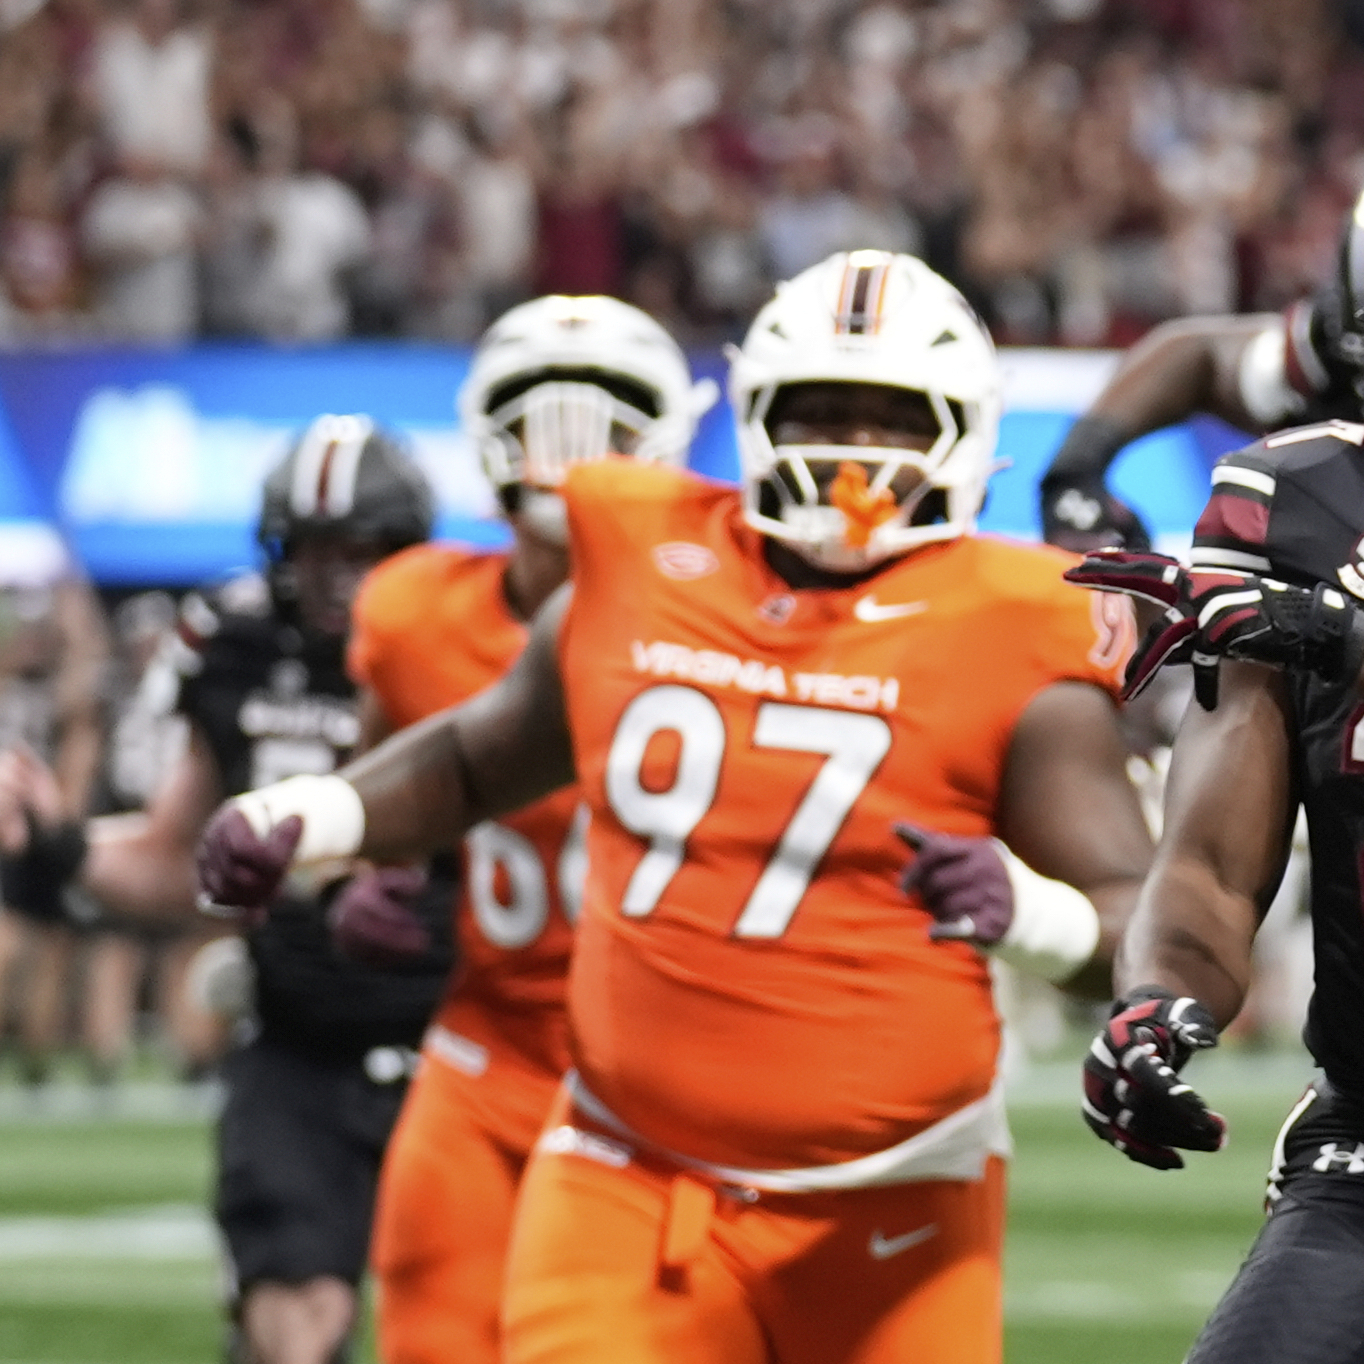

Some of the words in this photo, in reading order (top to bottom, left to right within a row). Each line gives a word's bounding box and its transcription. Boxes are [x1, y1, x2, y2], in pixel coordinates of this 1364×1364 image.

[630, 639, 788, 697] VIRGINIA
[792, 671, 900, 711] TECH
[604, 683, 893, 941] 97
